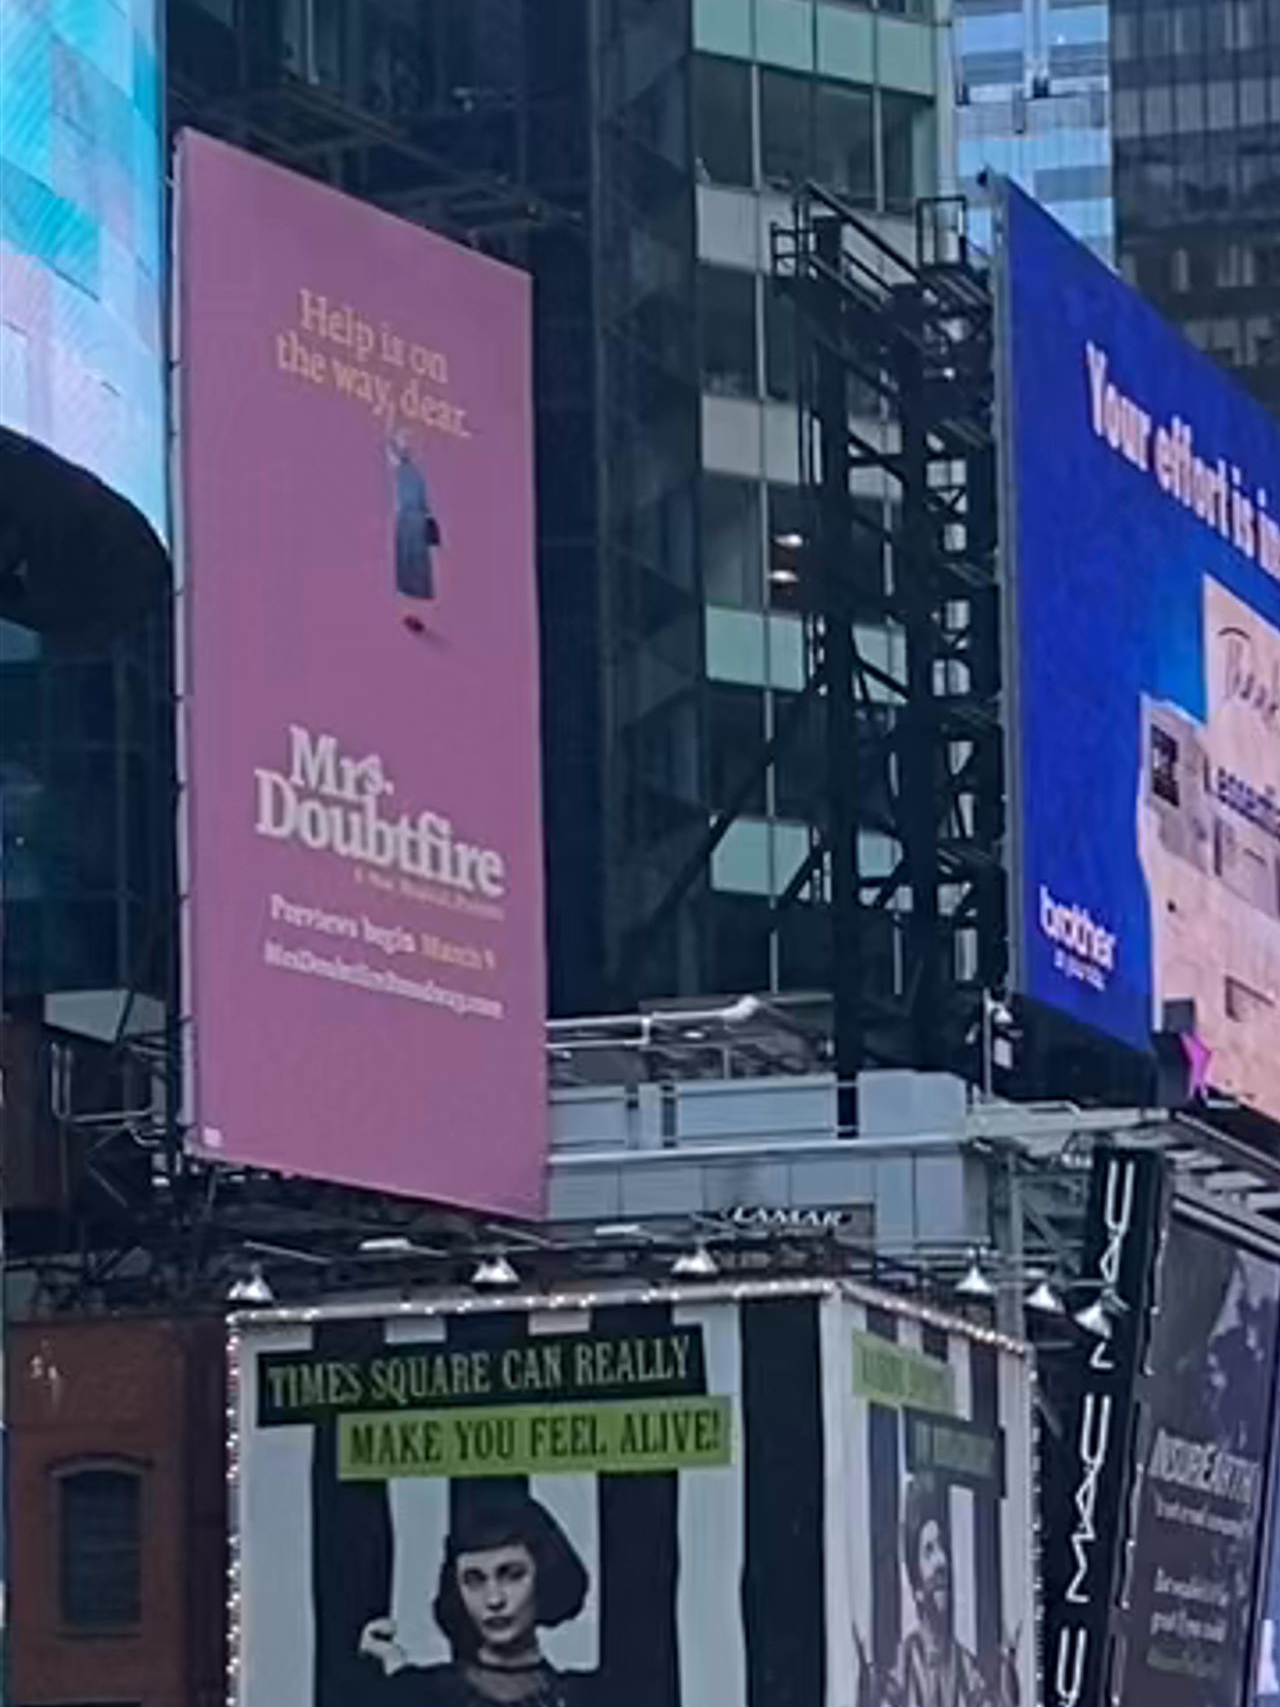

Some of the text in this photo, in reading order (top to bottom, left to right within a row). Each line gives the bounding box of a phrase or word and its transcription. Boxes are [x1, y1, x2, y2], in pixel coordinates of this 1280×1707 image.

[274, 329, 326, 384] the
[300, 288, 374, 362] Help
[410, 344, 448, 384] on
[1086, 339, 1152, 472] Your
[1154, 414, 1230, 538] effort
[1231, 466, 1256, 560] is
[289, 723, 395, 800] Mrs.
[253, 766, 505, 898] Doubtfire
[1039, 883, 1117, 971] brother
[270, 1334, 692, 1408] TIMES SQUARE CAN REALLY
[350, 1408, 722, 1465] MAKE YOU FEEL ALIVE!
